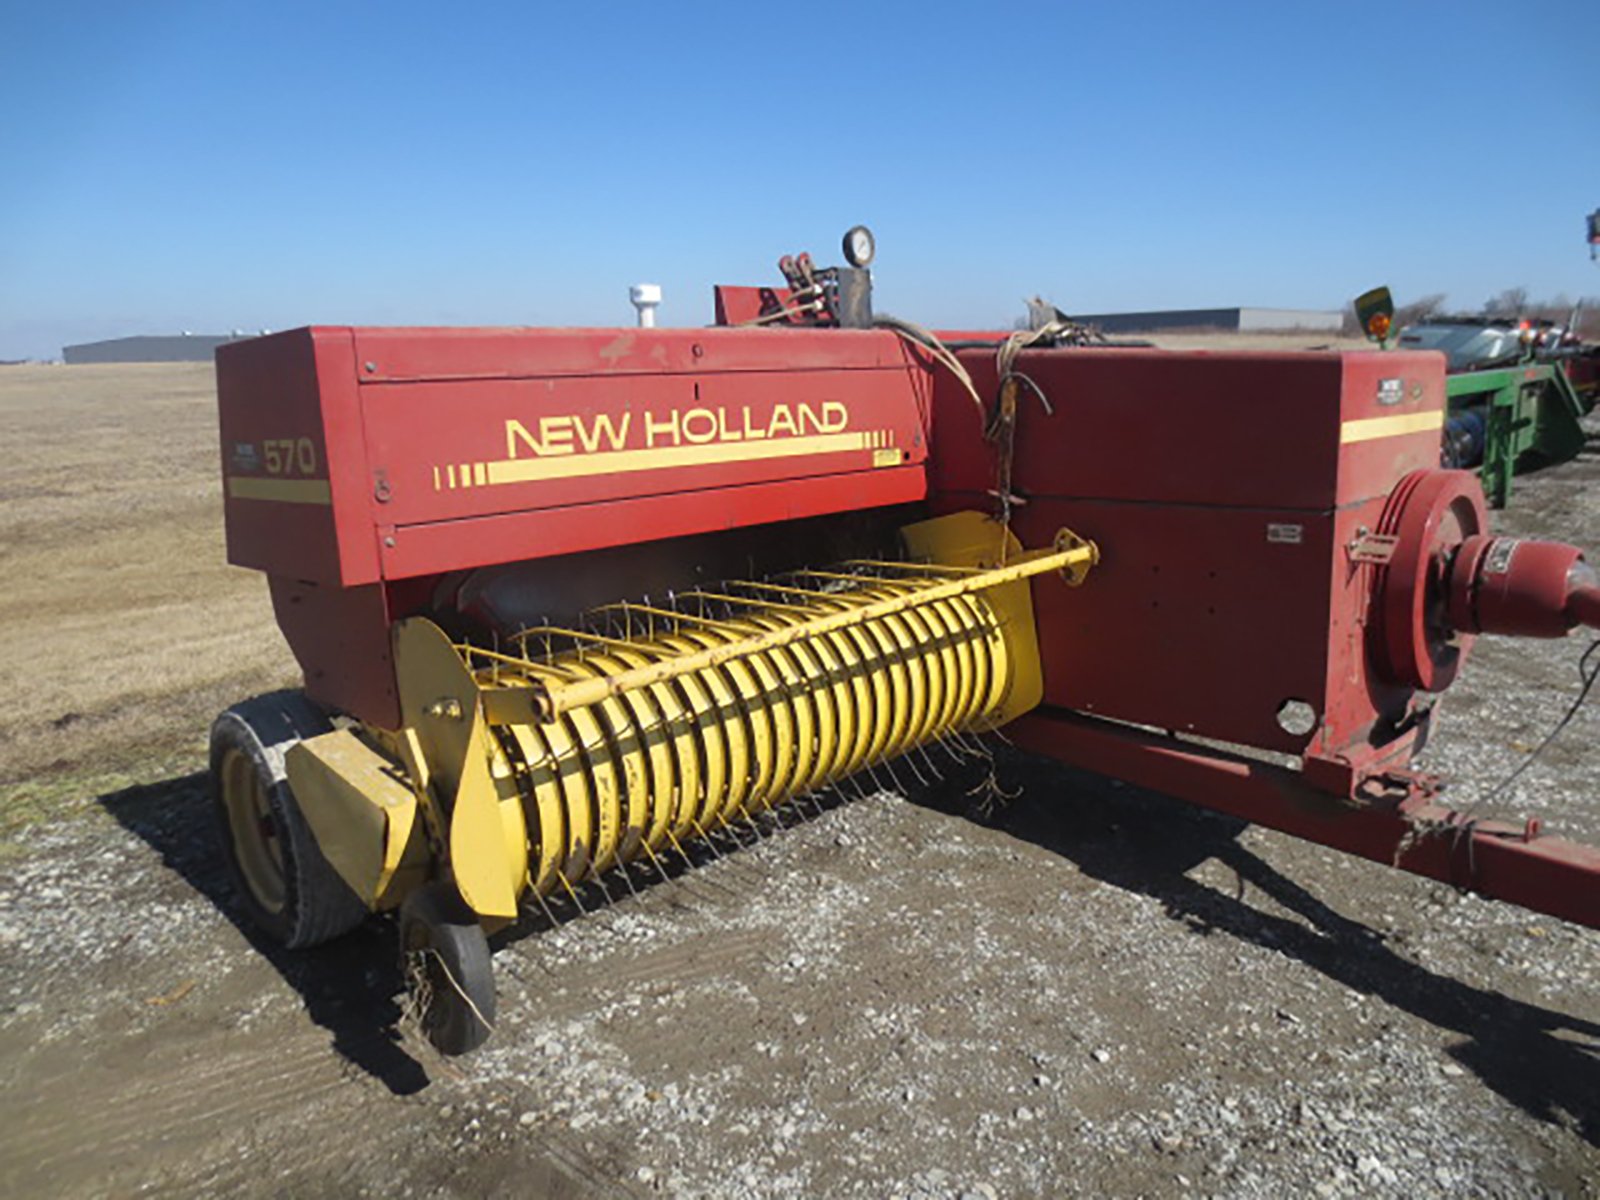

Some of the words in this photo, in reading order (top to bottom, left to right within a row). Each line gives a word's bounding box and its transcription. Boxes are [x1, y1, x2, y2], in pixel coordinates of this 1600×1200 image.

[506, 412, 630, 457] NEW
[645, 402, 847, 447] HOLLAND
[263, 437, 316, 475] 570
